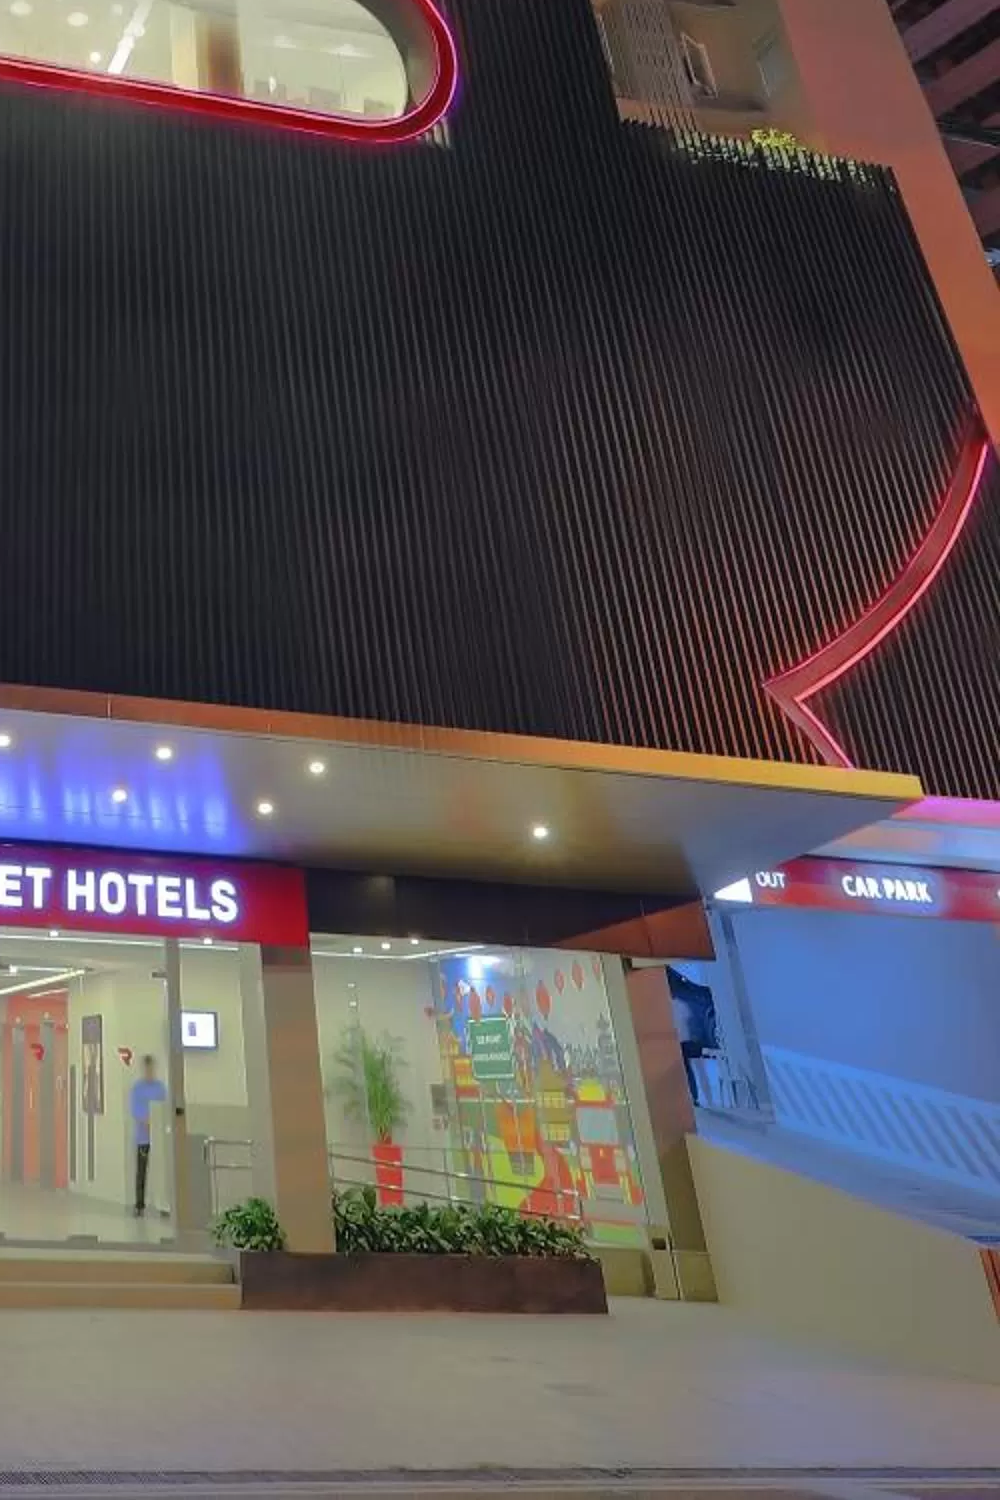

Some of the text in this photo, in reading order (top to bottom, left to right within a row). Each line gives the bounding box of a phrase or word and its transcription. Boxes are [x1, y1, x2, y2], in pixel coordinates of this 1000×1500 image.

[755, 871, 785, 889] OUT
[841, 875, 933, 903] CAR PARK
[67, 871, 239, 924] HOTELS
